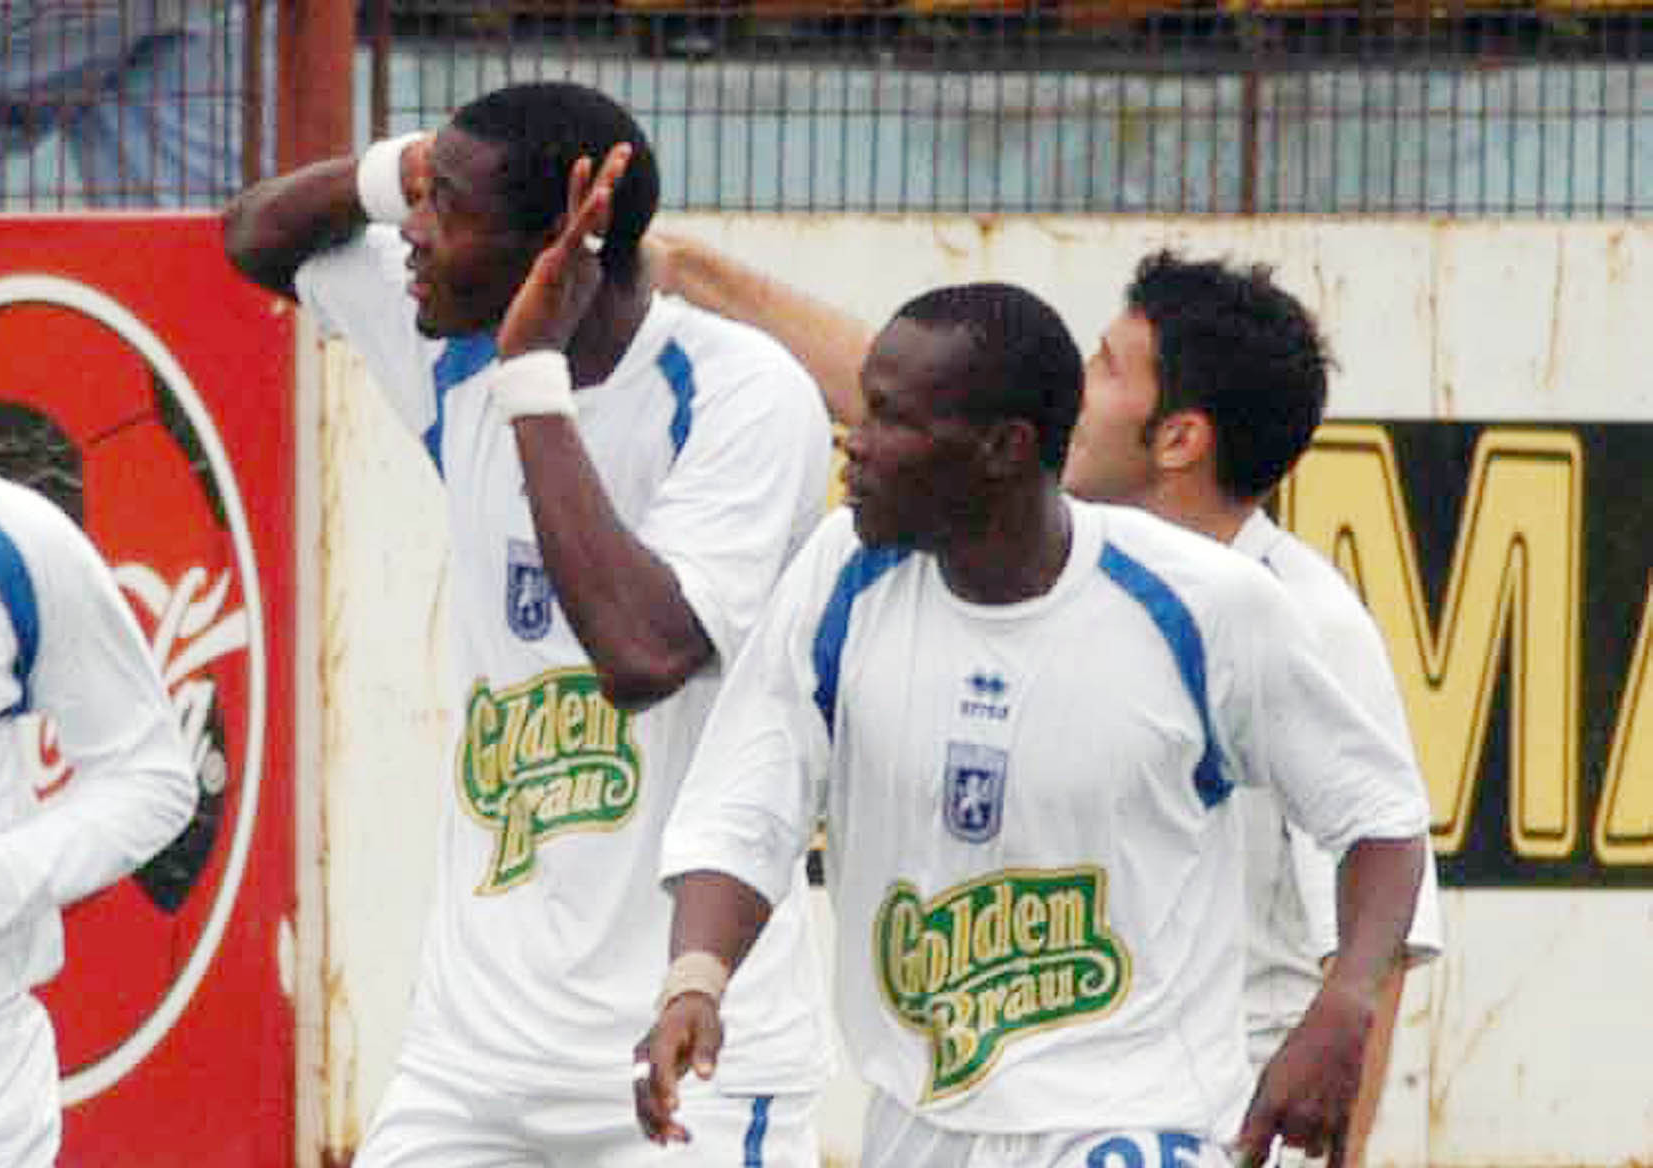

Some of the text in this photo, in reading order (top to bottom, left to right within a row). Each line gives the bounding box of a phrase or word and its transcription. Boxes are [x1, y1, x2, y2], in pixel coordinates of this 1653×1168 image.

[470, 682, 618, 792] Glden
[893, 884, 1086, 996] Golden
[931, 962, 1076, 1076] Brau
